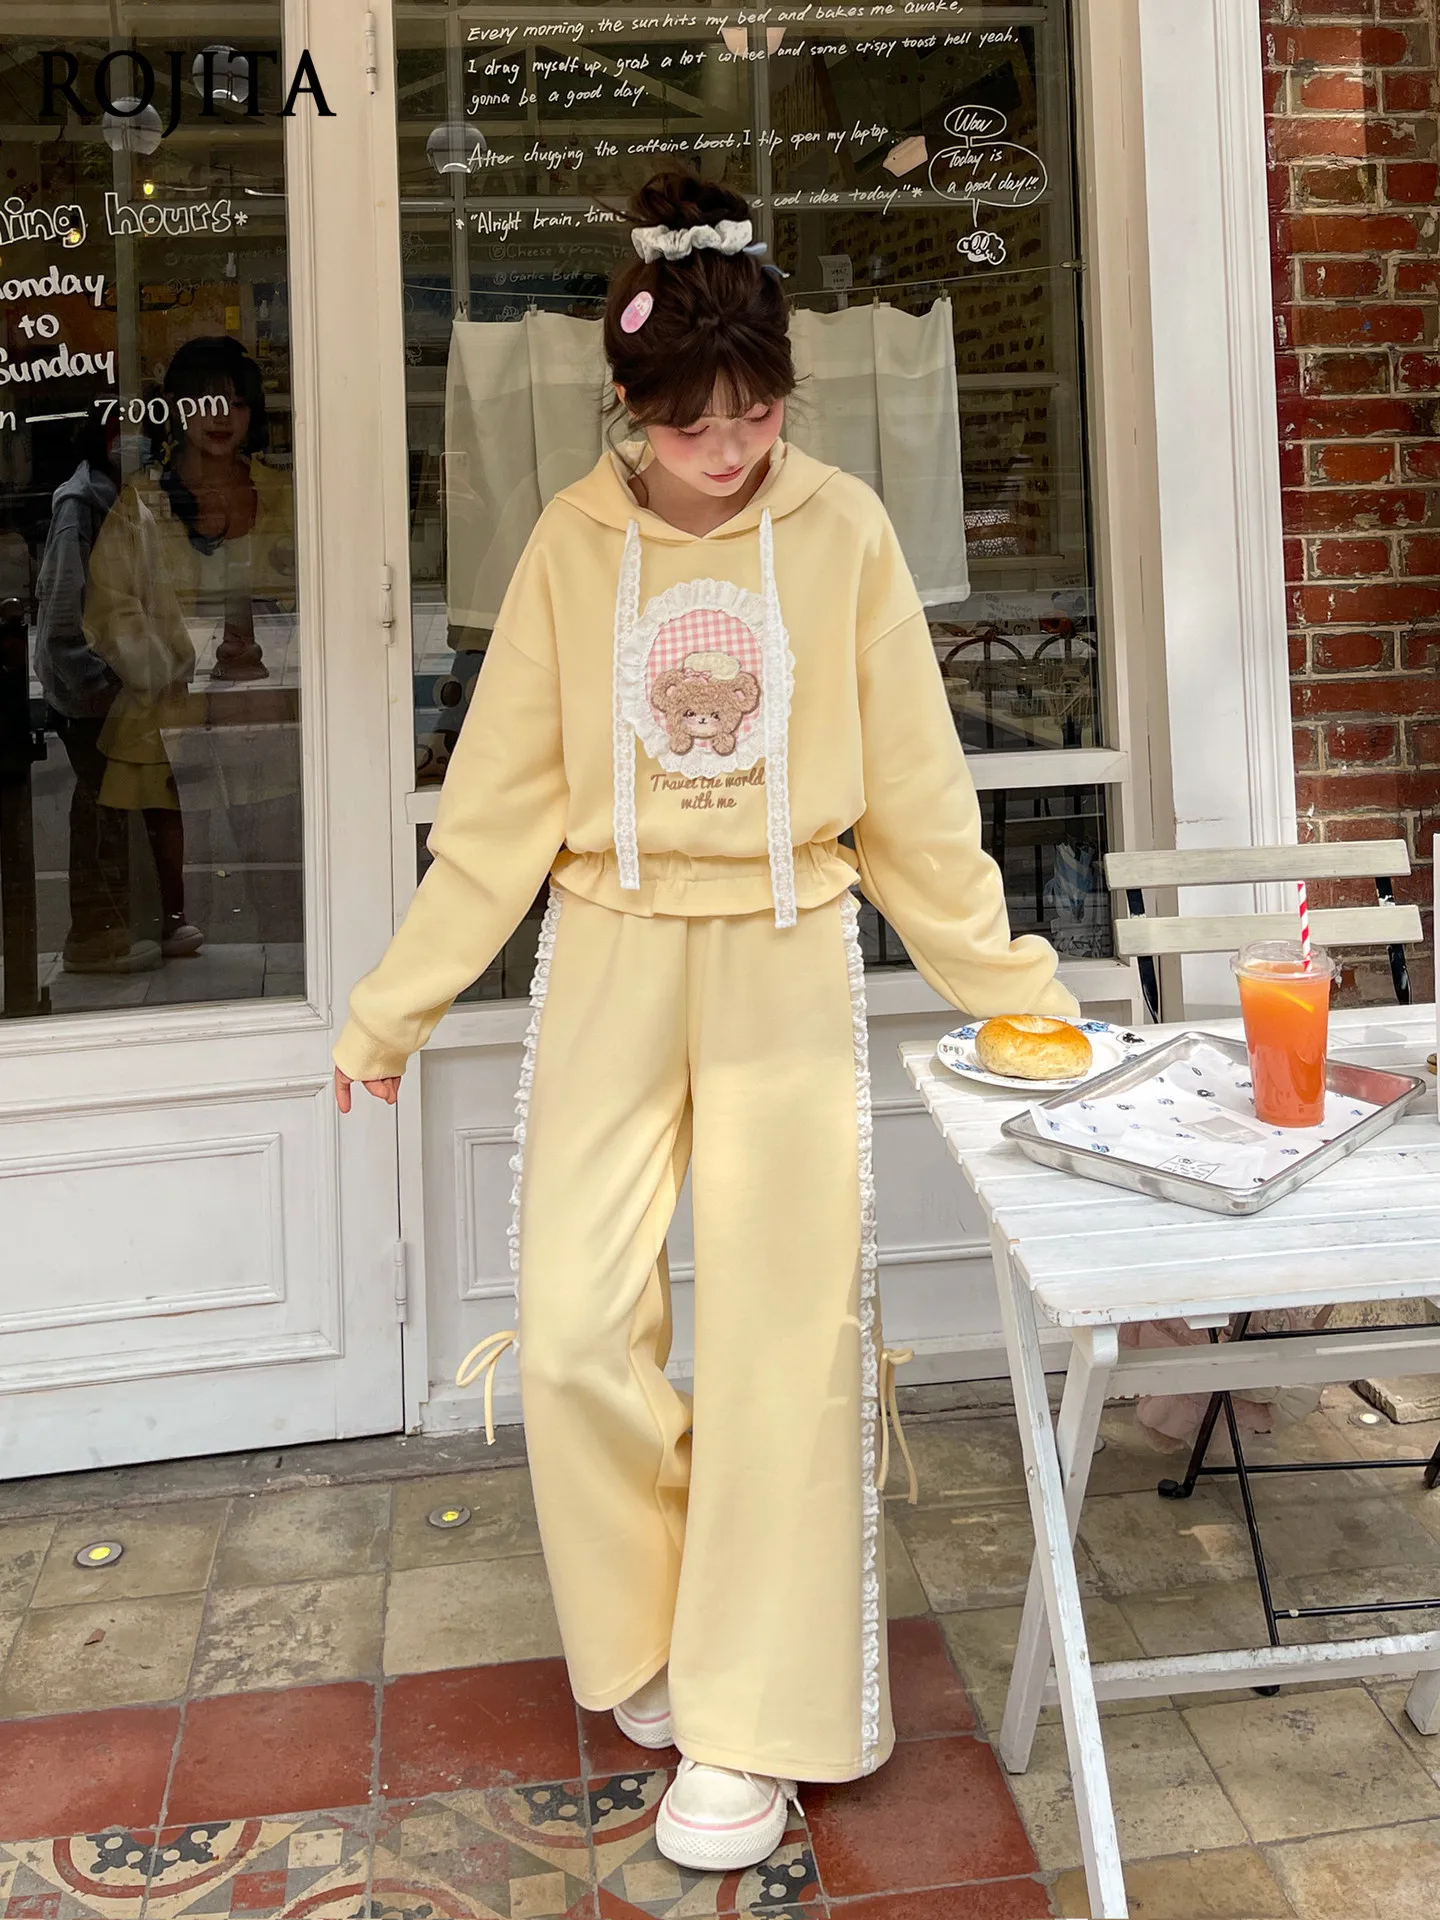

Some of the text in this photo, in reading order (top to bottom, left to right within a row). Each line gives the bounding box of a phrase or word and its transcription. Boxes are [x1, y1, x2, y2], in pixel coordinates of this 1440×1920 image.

[467, 26, 519, 44] Every
[598, 18, 625, 33] the
[632, 17, 659, 31] sun
[662, 13, 697, 28] hits
[705, 14, 729, 35] my
[737, 8, 773, 25] bed
[777, 4, 812, 21] and
[815, 7, 864, 20] bakes
[870, 4, 896, 16] me
[904, 0, 964, 15] awake,
[467, 59, 478, 73] I
[484, 58, 521, 84] drag
[532, 56, 580, 79] myself
[584, 62, 608, 78] up,
[614, 53, 649, 78] grab
[660, 55, 673, 68] a
[679, 49, 707, 66] hot
[777, 41, 806, 56] and
[810, 43, 848, 56] some
[855, 39, 897, 58] crispy
[901, 35, 936, 49] toast
[944, 32, 972, 47] hell
[466, 79, 649, 115] gonna be a good day.
[954, 109, 993, 132] Wow
[466, 142, 515, 168] After
[523, 141, 584, 170] chugging
[594, 139, 619, 157] the
[627, 138, 690, 154] caffeine
[693, 133, 741, 151] boost,
[742, 129, 752, 146] I
[790, 131, 822, 151] open
[826, 130, 847, 154] my
[941, 148, 1003, 176] Today is
[773, 189, 802, 207] cool
[809, 188, 840, 205] idea
[947, 181, 957, 194] a
[963, 172, 998, 200] good
[533, 208, 581, 231] brain,
[0, 264, 105, 308] onday
[18, 314, 60, 339] to
[0, 342, 115, 386] Sunday
[94, 397, 170, 426] 7:00
[176, 394, 230, 430] pm
[725, 766, 766, 788] world
[680, 790, 738, 810] with me
